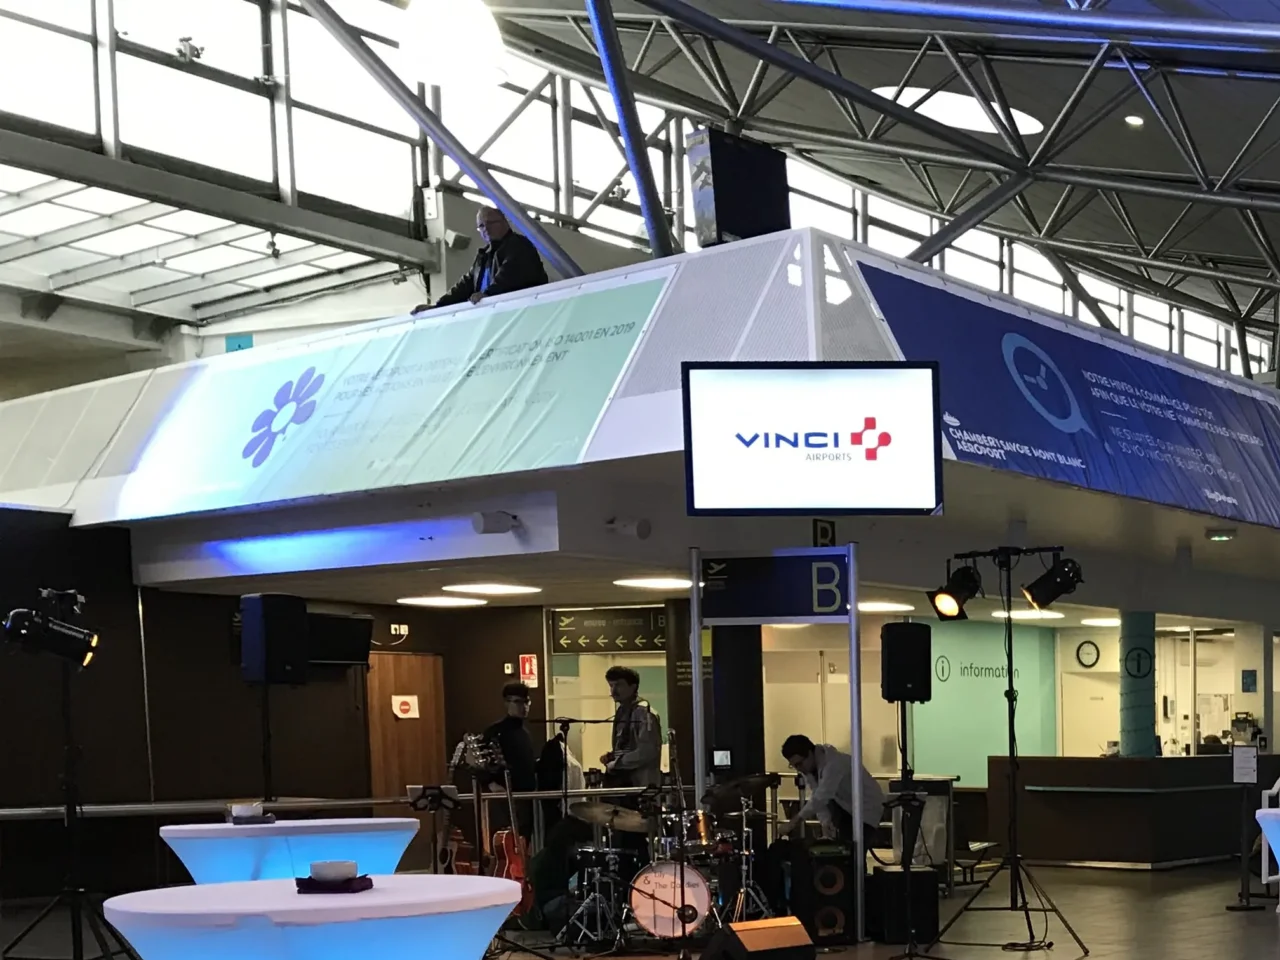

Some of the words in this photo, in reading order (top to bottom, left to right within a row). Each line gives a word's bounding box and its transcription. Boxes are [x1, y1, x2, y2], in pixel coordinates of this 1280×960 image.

[564, 331, 592, 344] 14001
[593, 327, 610, 340] EN
[611, 321, 636, 337] 2019
[735, 432, 840, 448] VINCI
[805, 452, 852, 462] AIRPORTS
[956, 440, 1007, 460] AÉROPORT
[1000, 440, 1032, 457] SAVOIE
[1033, 446, 1058, 462] MONT
[1058, 453, 1086, 468] BLANC
[811, 561, 842, 613] B
[960, 662, 1020, 679] informatin
[671, 881, 700, 889] Dadies
